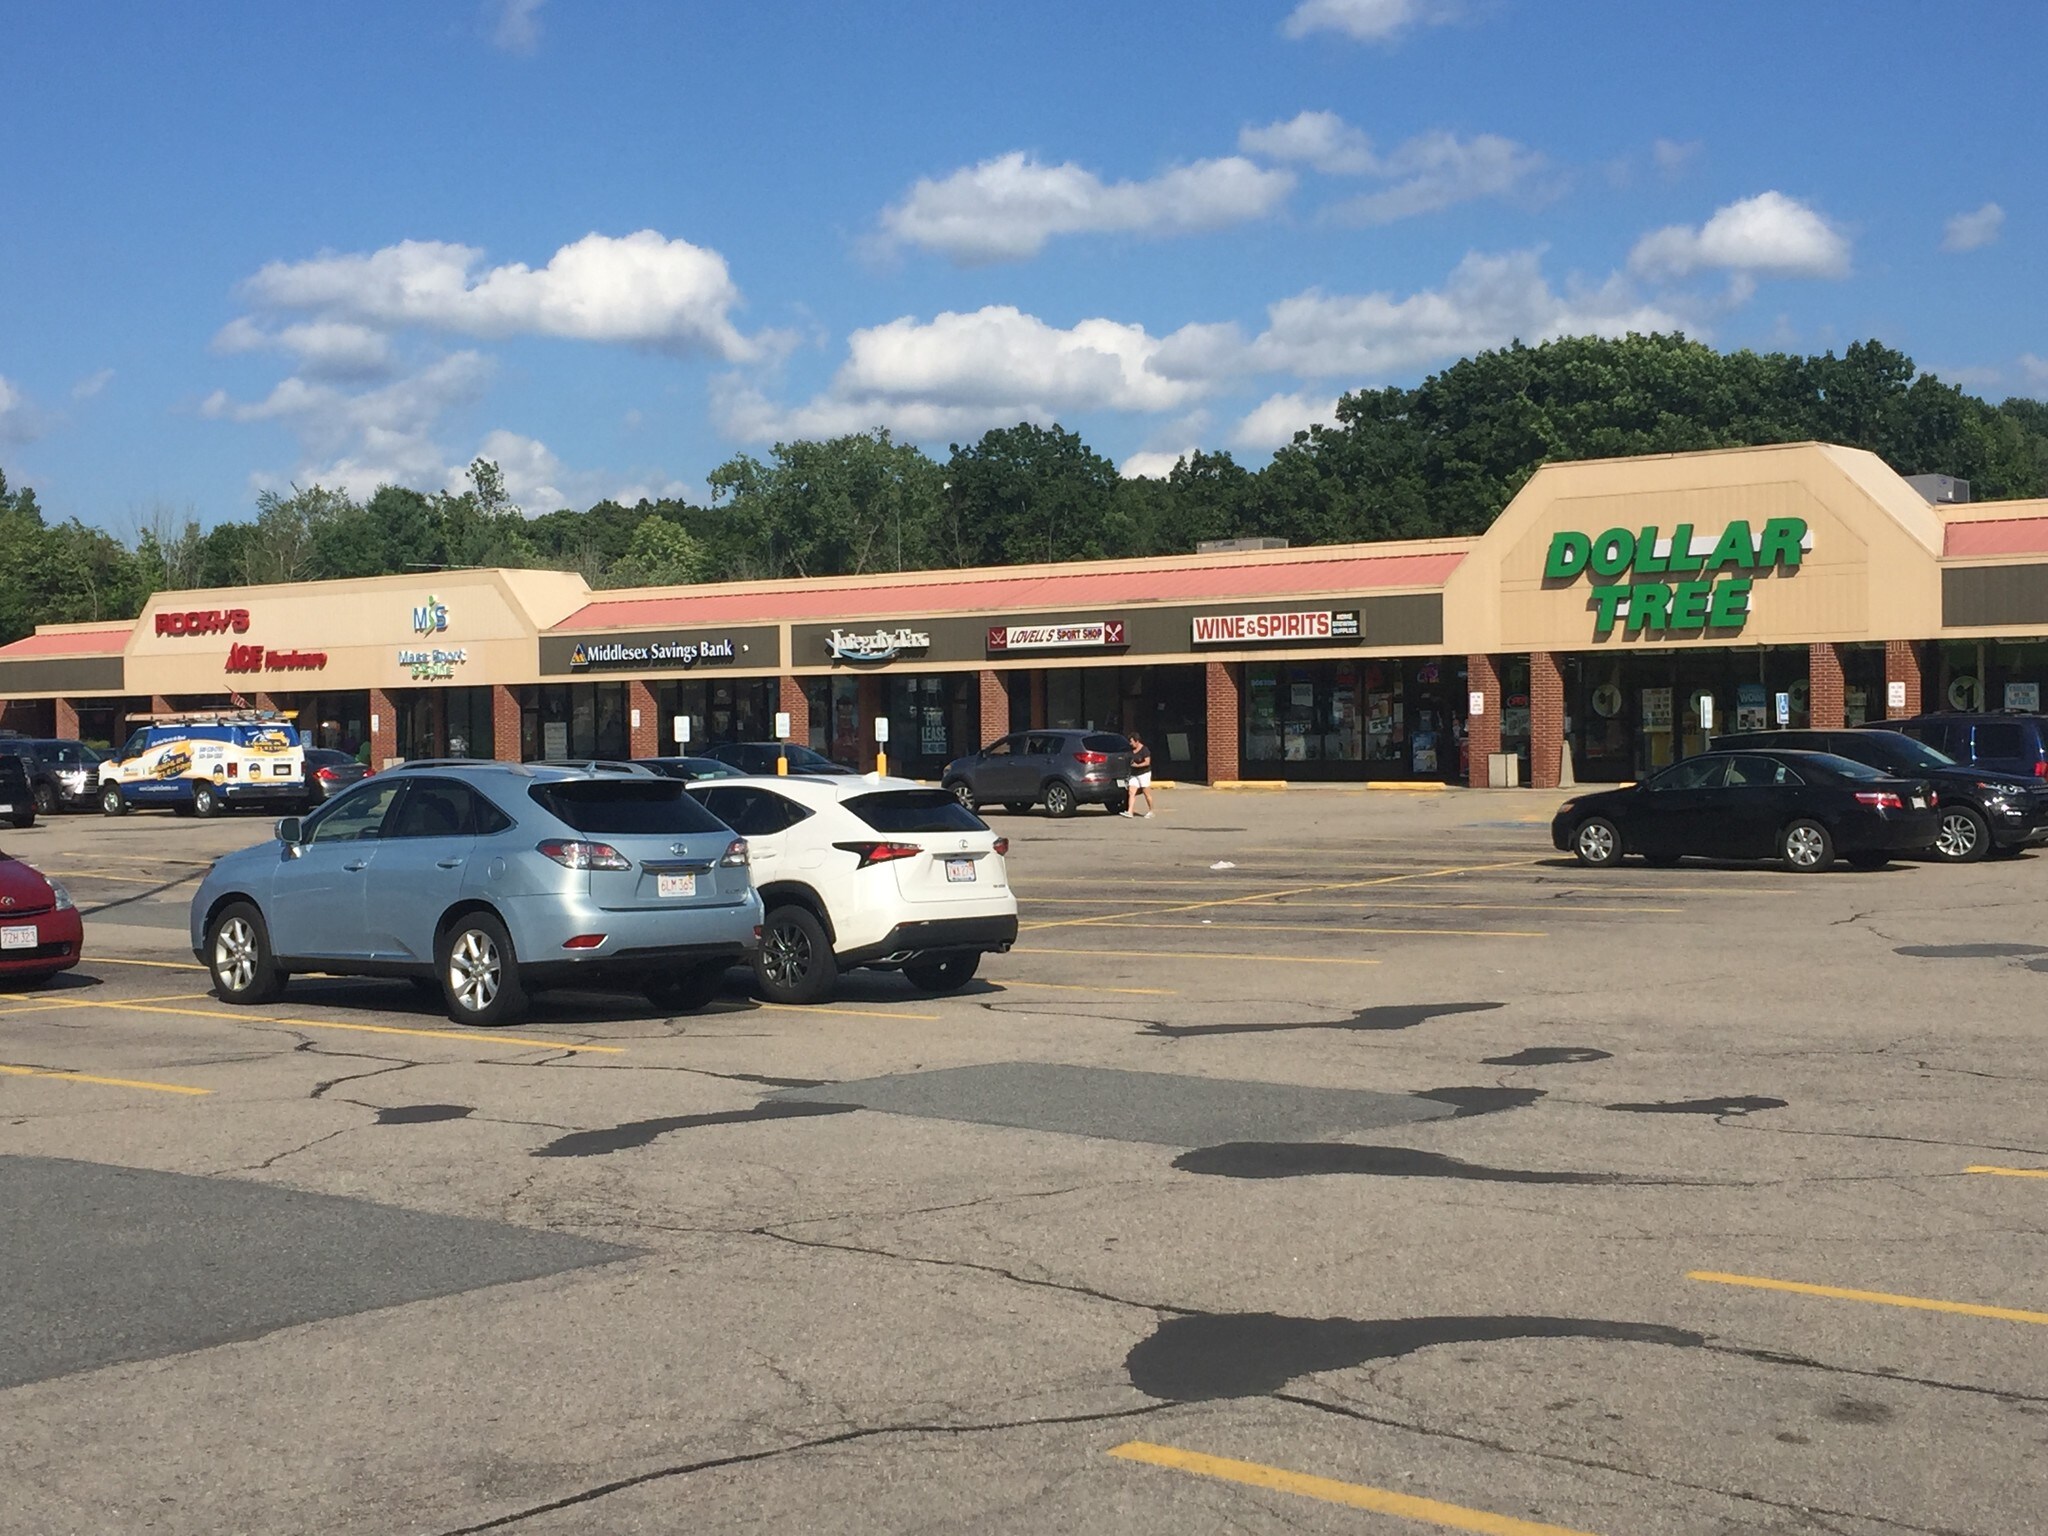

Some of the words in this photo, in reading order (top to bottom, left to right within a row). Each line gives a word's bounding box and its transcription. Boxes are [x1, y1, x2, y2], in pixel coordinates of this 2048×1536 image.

[1545, 517, 1808, 578] DOLLAR
[1591, 578, 1753, 632] TREE
[155, 609, 249, 635] ROCKY'S
[1009, 628, 1056, 644] LOVELL'S
[1056, 628, 1081, 640] SPORT
[1082, 626, 1102, 639] SHOP
[587, 643, 648, 662] Middlesex
[651, 642, 698, 663] Savings
[700, 639, 733, 658] Bank
[921, 727, 947, 741] LEASE
